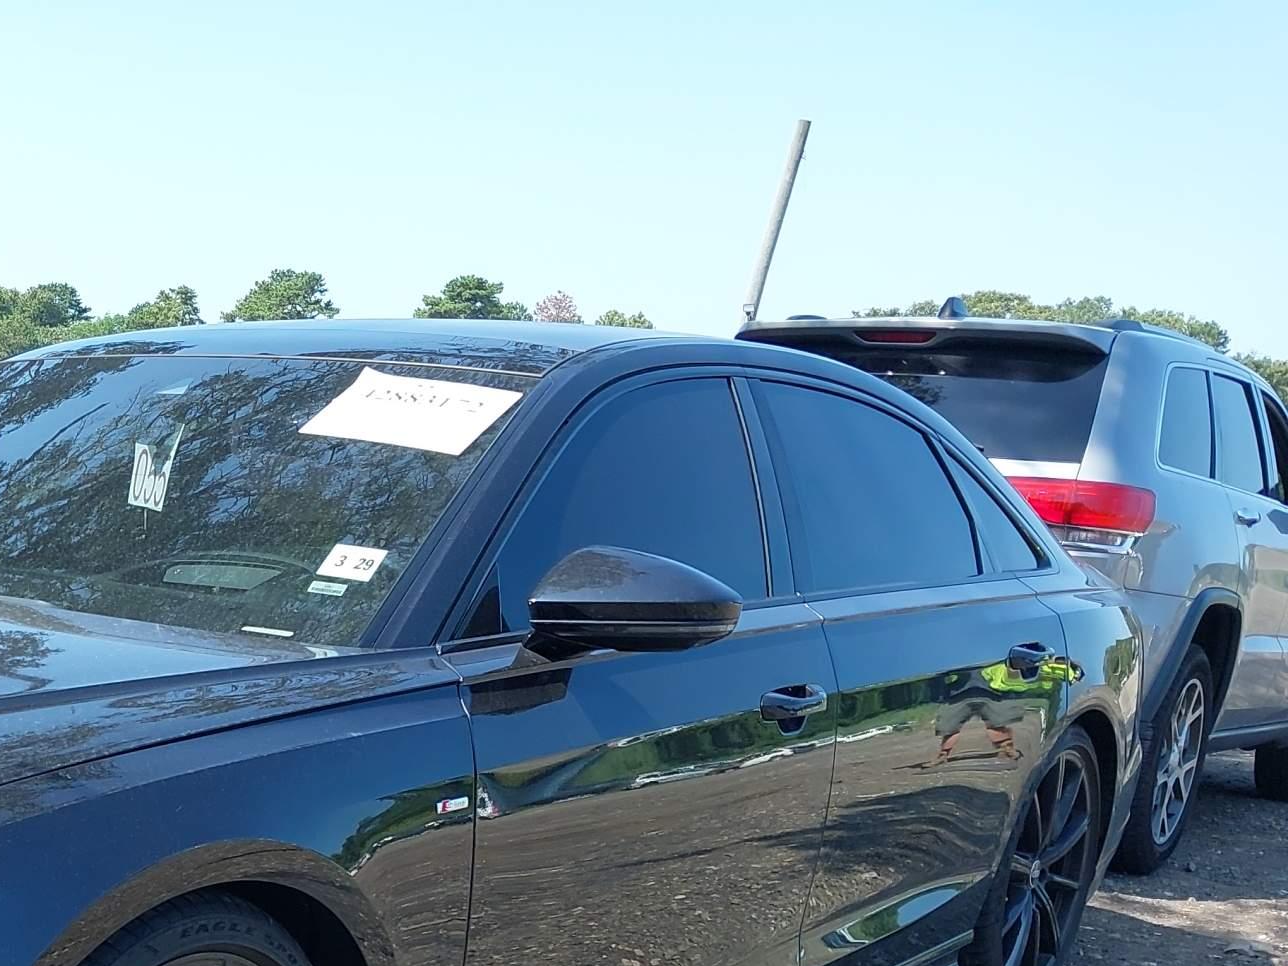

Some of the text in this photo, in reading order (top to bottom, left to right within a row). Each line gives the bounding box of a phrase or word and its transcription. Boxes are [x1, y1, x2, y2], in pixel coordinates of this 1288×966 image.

[334, 554, 375, 571] 3 29
[180, 920, 257, 939] EAGLE
